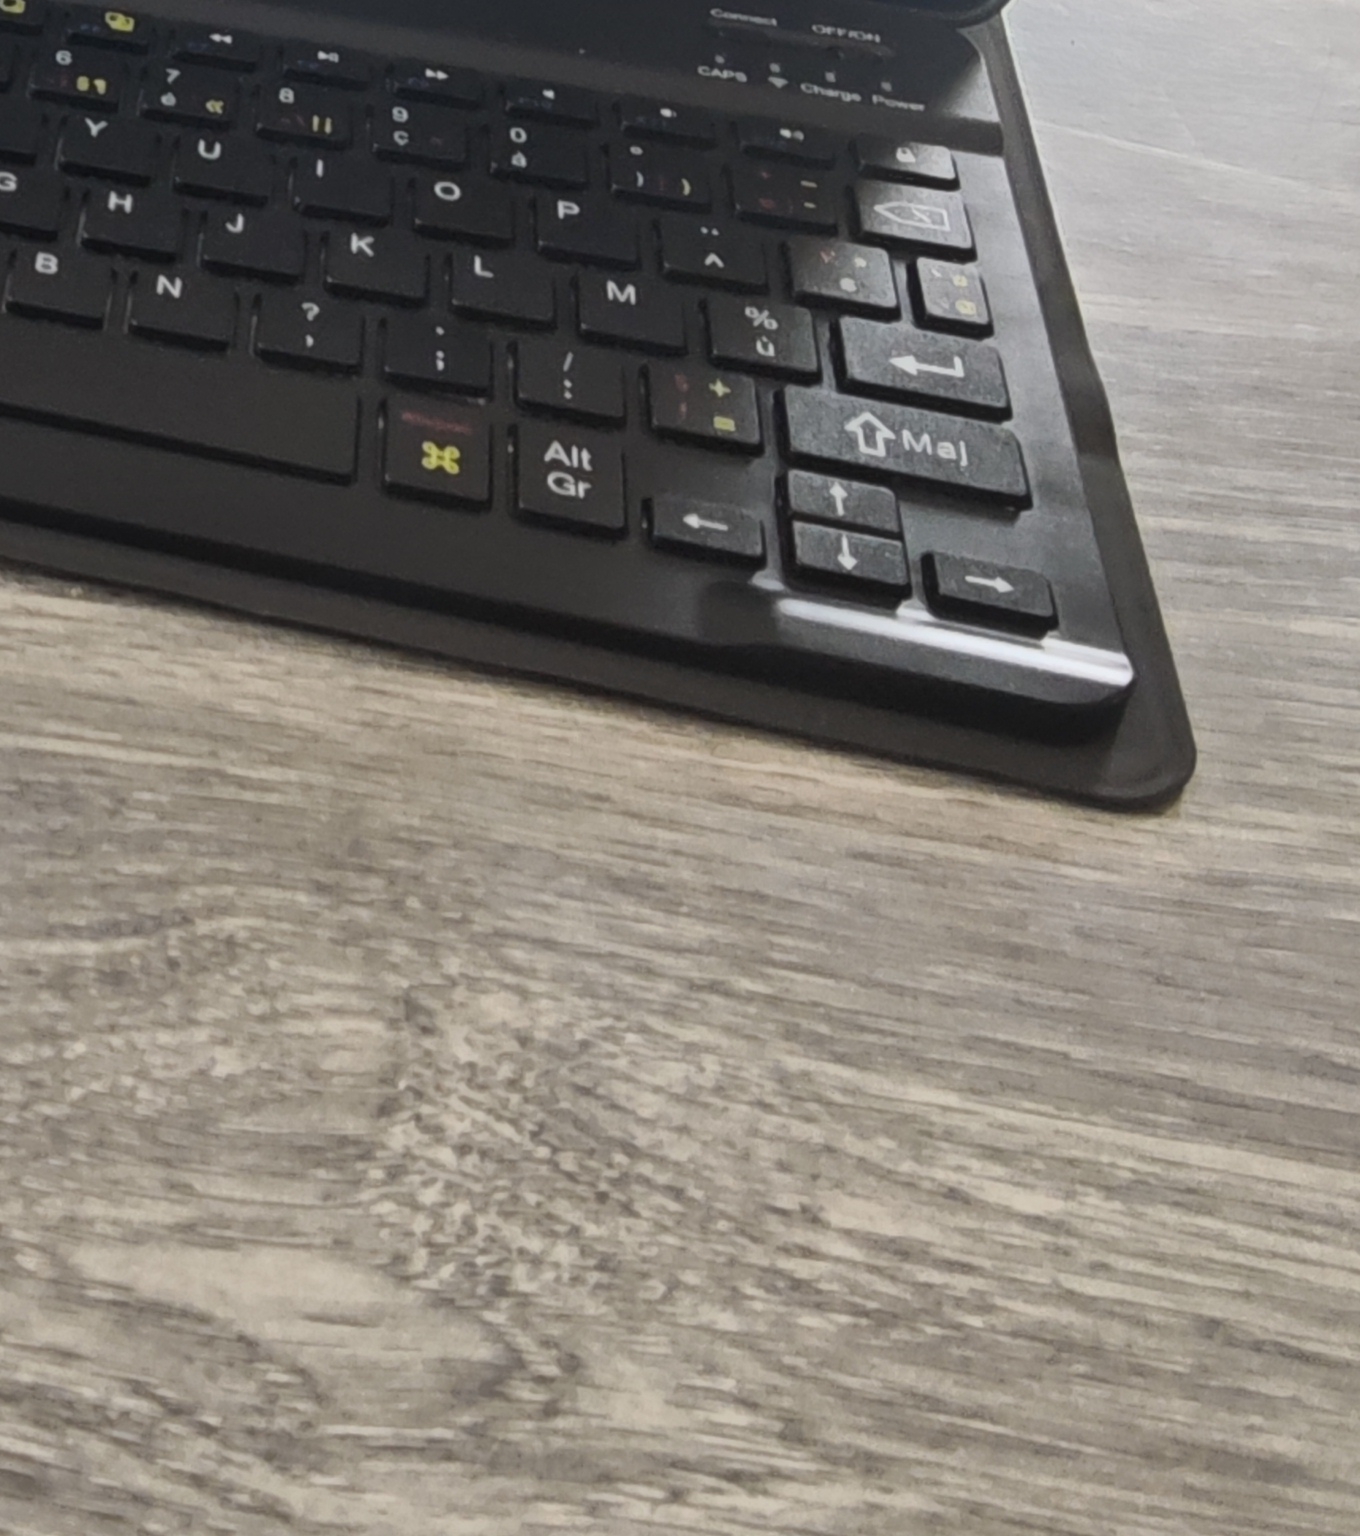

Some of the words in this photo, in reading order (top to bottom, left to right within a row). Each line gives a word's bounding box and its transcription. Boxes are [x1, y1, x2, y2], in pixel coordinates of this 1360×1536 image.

[709, 7, 778, 27] Connect
[55, 50, 73, 66] 6
[165, 68, 181, 84] 7
[278, 87, 295, 104] 8
[697, 65, 748, 83] CAPS
[800, 82, 862, 102] Charge
[871, 94, 926, 112] Power
[391, 106, 409, 123] 9
[84, 117, 109, 138] Y
[197, 138, 221, 161] U
[108, 192, 133, 213] H
[433, 181, 462, 202] O
[557, 199, 581, 220] P
[226, 214, 244, 233] J
[350, 233, 375, 257] K
[35, 252, 58, 275] B
[473, 255, 494, 278] L
[156, 275, 182, 298] N
[607, 281, 636, 305] M
[302, 303, 319, 321] ?
[744, 306, 779, 330] %
[544, 440, 592, 472] Alt
[902, 429, 968, 467] Maj
[546, 472, 592, 499] Gr
